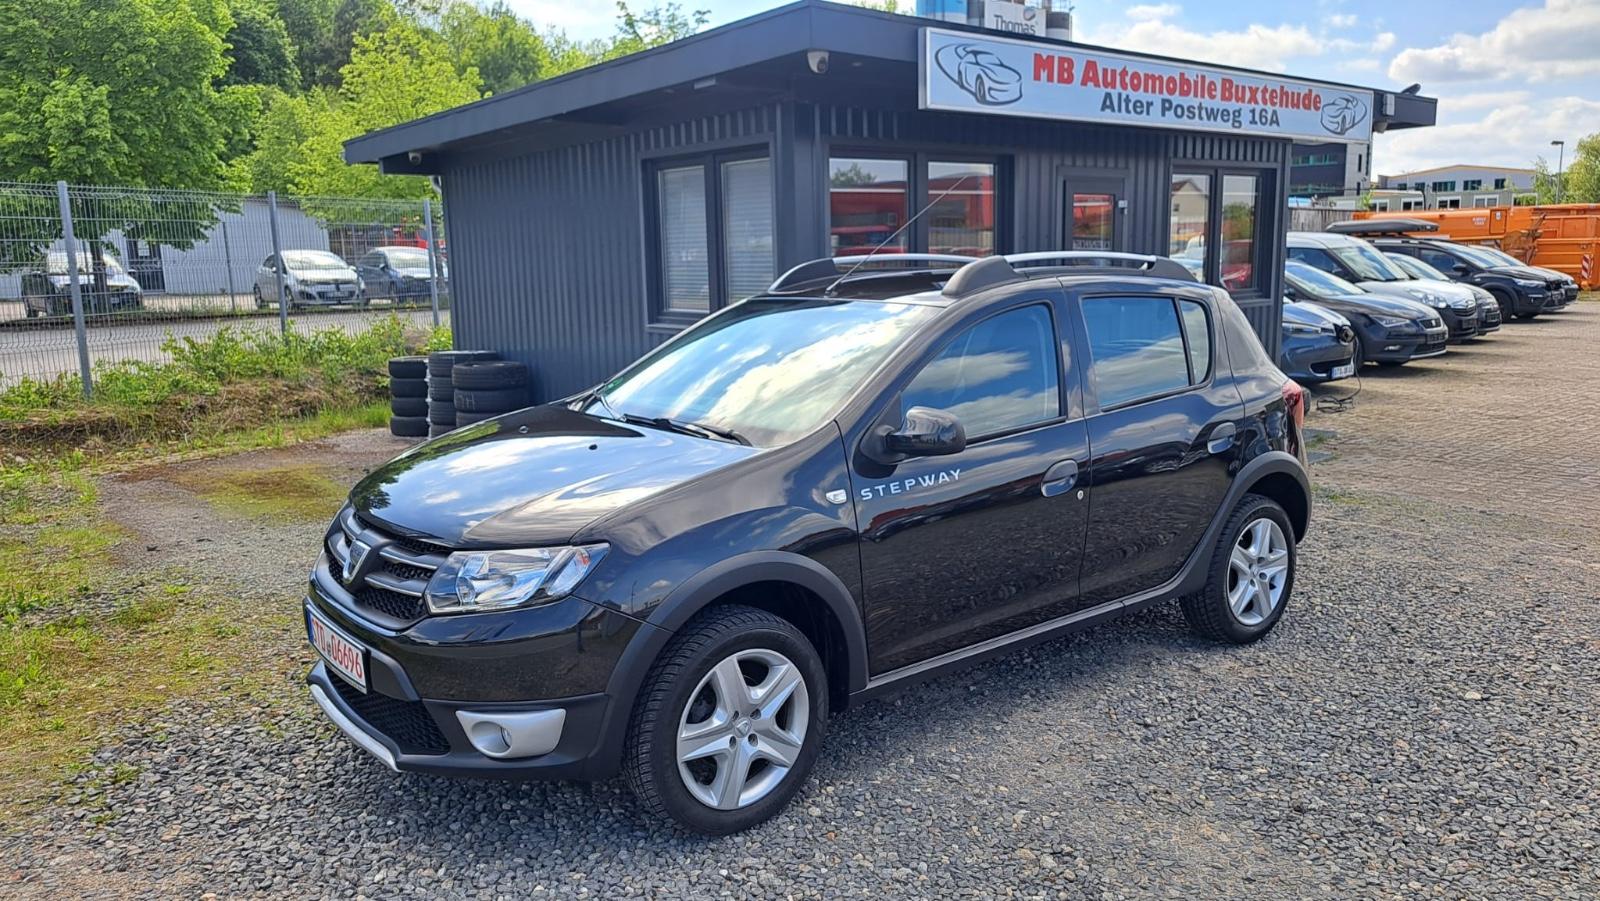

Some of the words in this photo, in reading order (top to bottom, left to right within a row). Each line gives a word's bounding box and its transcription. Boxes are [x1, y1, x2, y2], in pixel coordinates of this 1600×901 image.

[994, 14, 1036, 35] Thomas
[1033, 53, 1075, 85] MB
[1080, 60, 1217, 101] Automobile
[1220, 78, 1322, 112] Buxtehude
[1100, 92, 1154, 117] Alter
[1160, 98, 1243, 129] Postweg
[1249, 107, 1280, 127] 16A
[861, 469, 961, 501] STEPWAY
[331, 634, 363, 679] 06696
